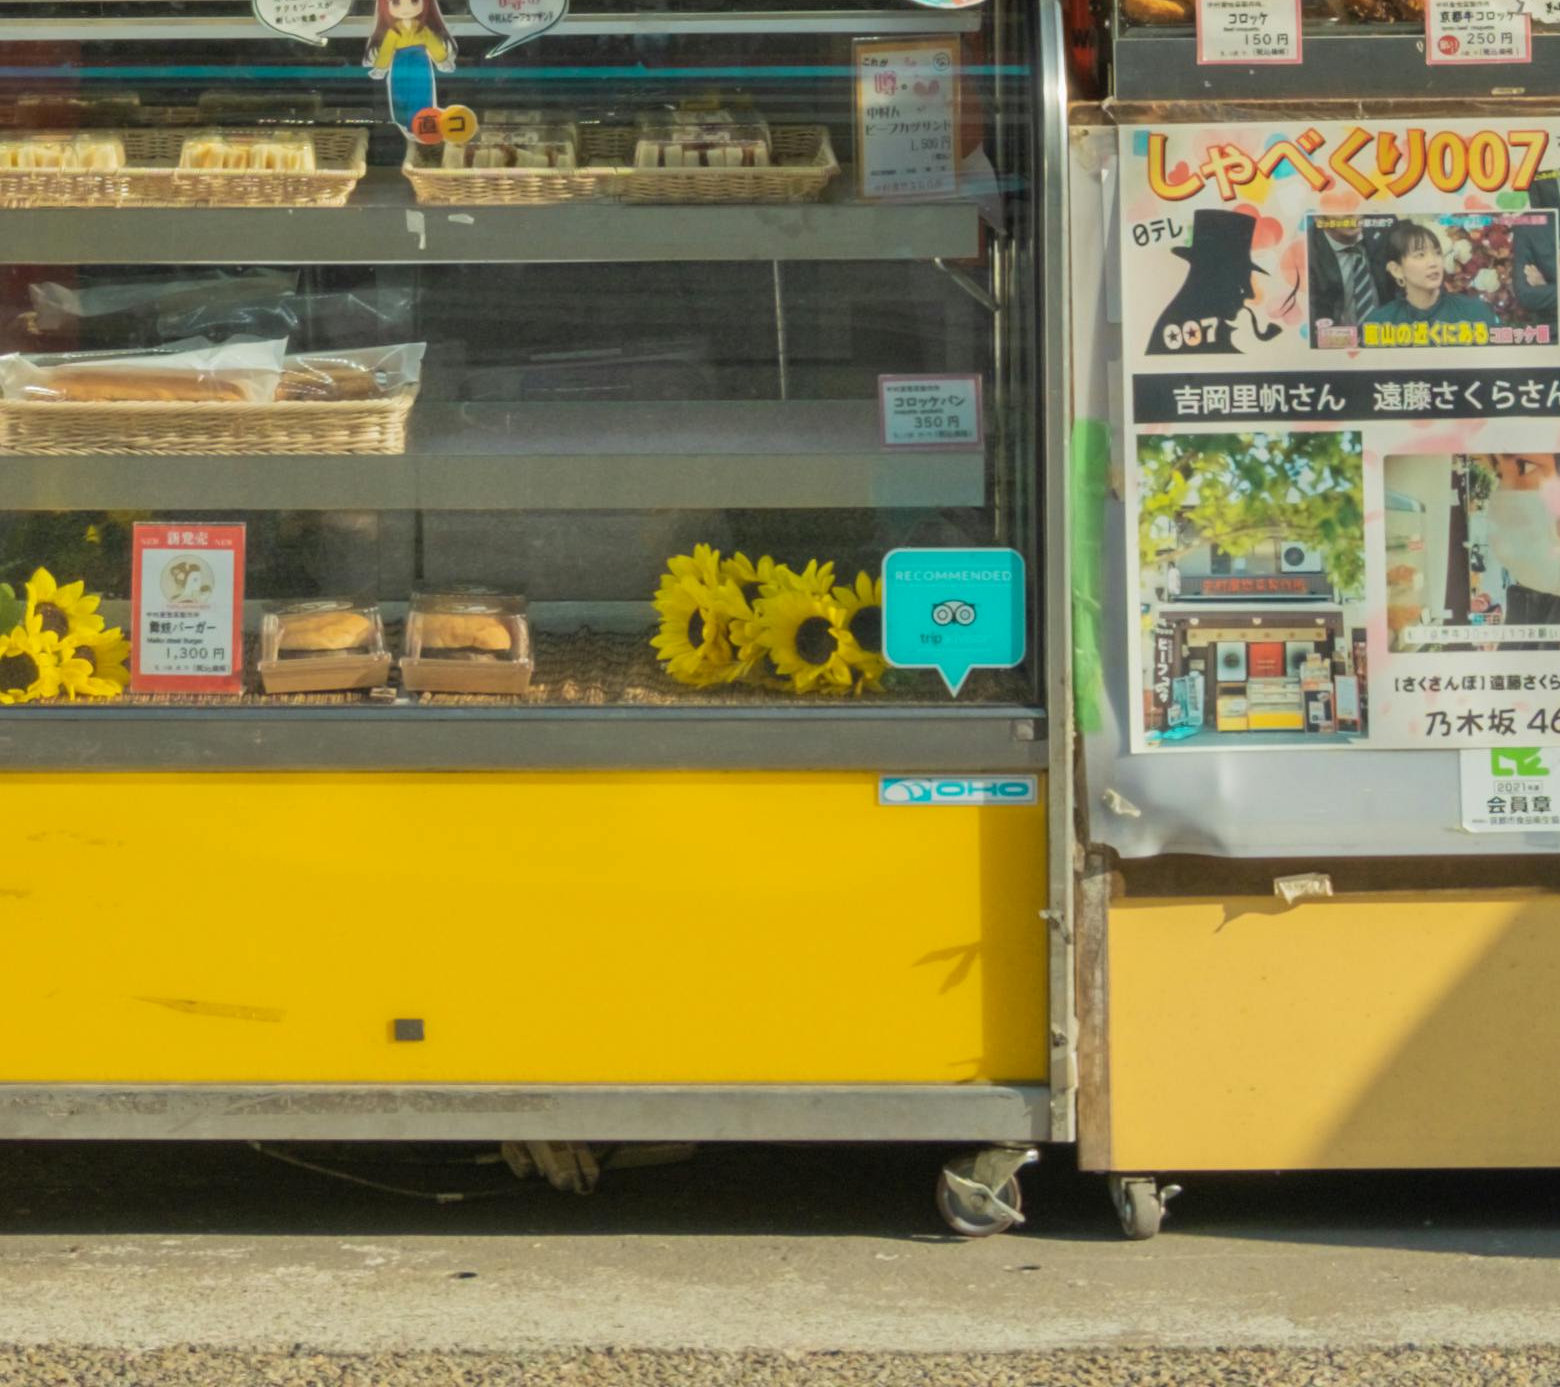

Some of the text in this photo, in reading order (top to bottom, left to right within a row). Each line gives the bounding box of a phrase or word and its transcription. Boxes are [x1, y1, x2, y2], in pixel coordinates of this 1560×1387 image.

[1227, 12, 1270, 25] コロッケ
[1439, 9, 1516, 24] 京都牛コロッケ
[1242, 33, 1290, 47] 150円
[1466, 32, 1514, 46] 250円
[1146, 125, 1551, 202] しゃべくり007
[1131, 216, 1184, 247] 日テレ
[893, 394, 966, 409] コロッケパン
[1172, 382, 1347, 415] 吉岡里帆さん
[914, 415, 960, 429] 350円
[166, 530, 210, 547] 新発売
[894, 570, 1012, 583] RECOMMENDED
[165, 646, 225, 662] 1,300円
[1424, 707, 1517, 738] 乃木坂
[1486, 797, 1553, 815] 会員章
